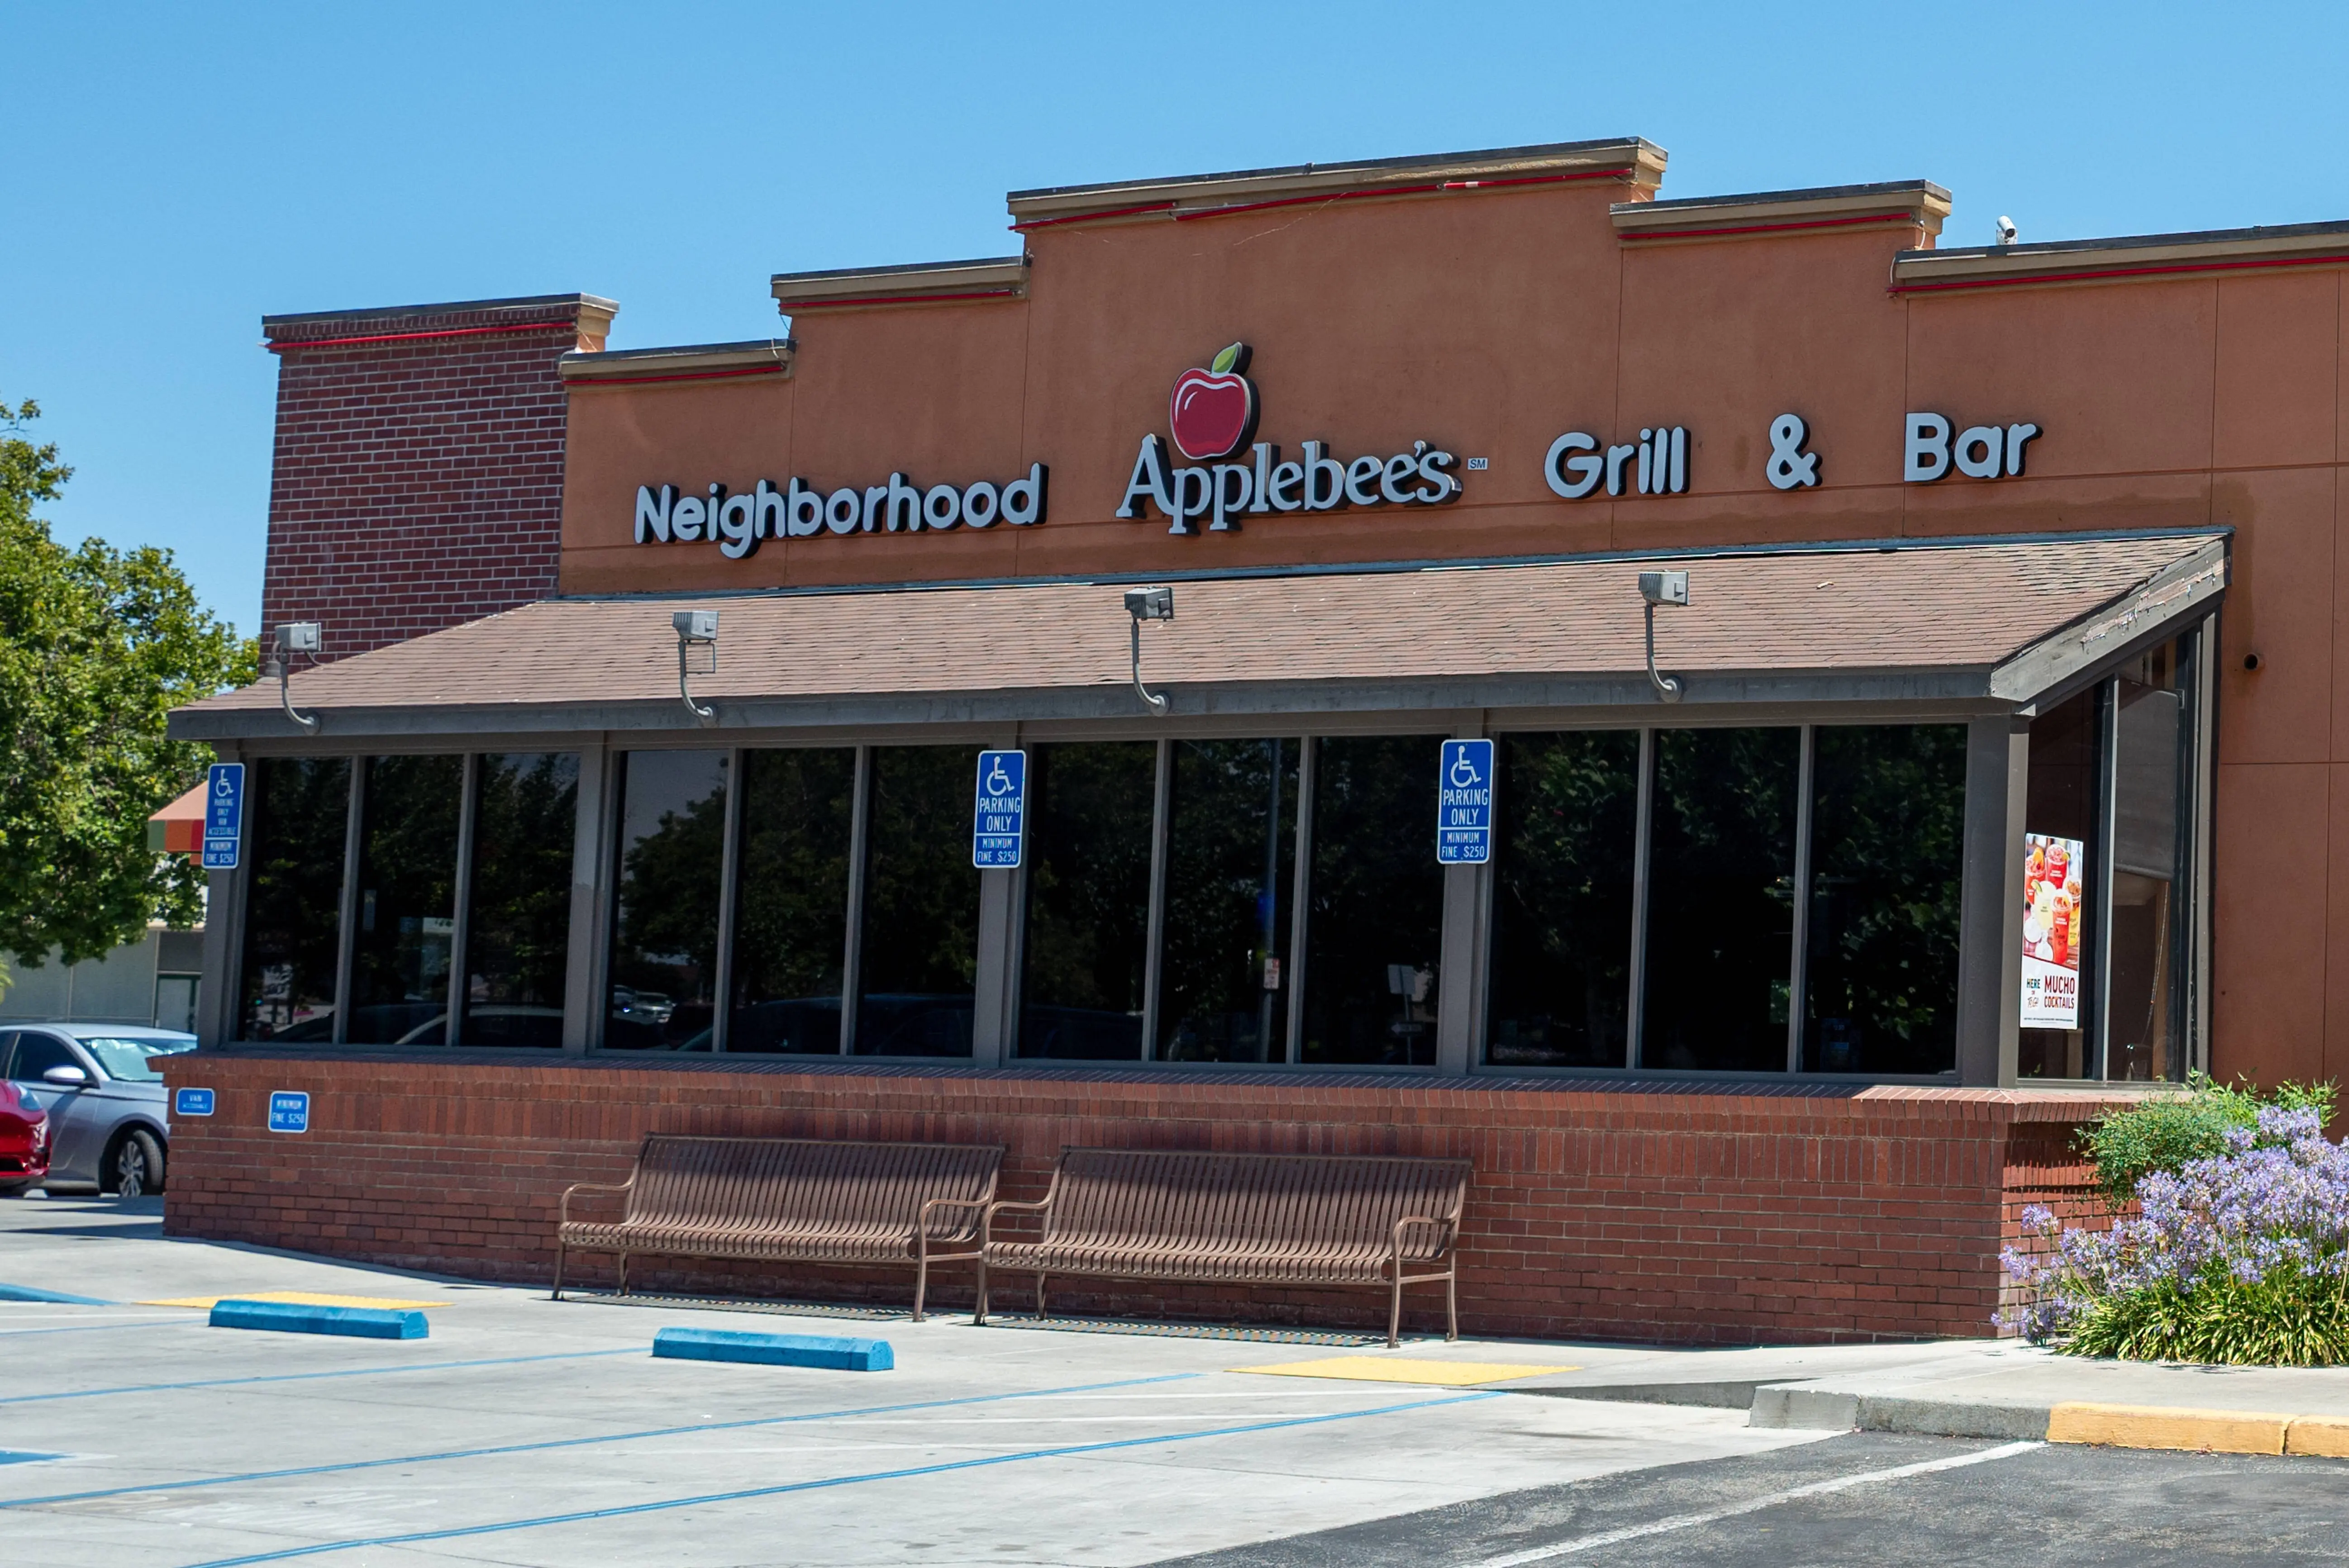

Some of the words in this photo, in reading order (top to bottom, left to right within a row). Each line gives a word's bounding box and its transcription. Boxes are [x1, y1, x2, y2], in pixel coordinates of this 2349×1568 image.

[635, 462, 1046, 559] Neighborhood
[1115, 433, 1460, 535] Applebee's
[1470, 459, 1486, 469] SM
[1544, 426, 1690, 499] Grill
[1766, 413, 1822, 490] &
[1904, 411, 2042, 482] Bar
[1443, 789, 1488, 805] PARKING
[979, 797, 1020, 813] PARKING
[1451, 808, 1479, 825] ONLY
[986, 816, 1012, 832] ONLY
[983, 838, 1012, 849] MINIMUM
[1447, 832, 1479, 843] MINIMUM
[977, 851, 992, 862] FINE
[997, 851, 1016, 862] $250
[1442, 846, 1458, 857] FINE
[1463, 846, 1484, 858] $250
[2027, 978, 2040, 988] HERE
[2044, 975, 2075, 994] MUCHO
[2044, 996, 2074, 1009] COCKTAILS
[272, 1112, 285, 1123] FINE
[288, 1113, 305, 1124] $250
